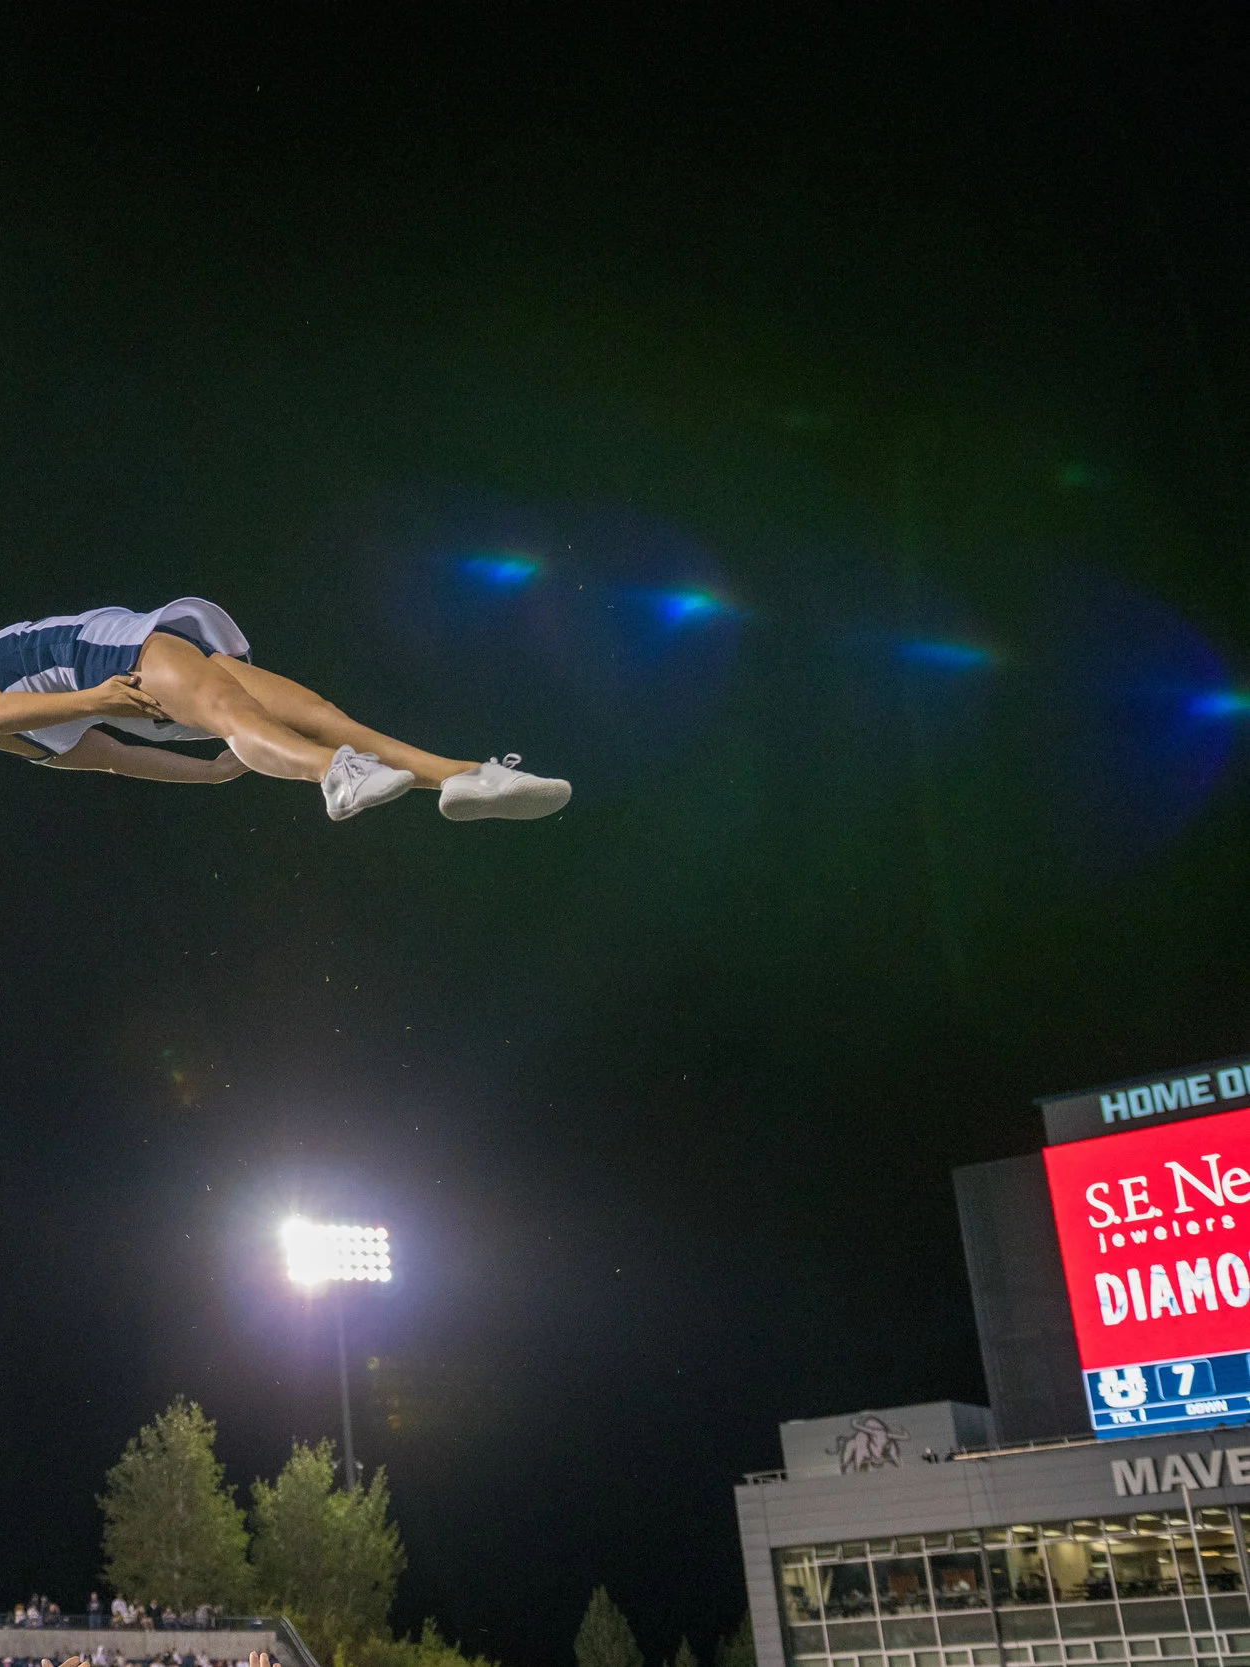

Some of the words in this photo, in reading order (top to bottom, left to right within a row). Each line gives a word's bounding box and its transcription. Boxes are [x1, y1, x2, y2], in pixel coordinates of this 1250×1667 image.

[1101, 1074, 1216, 1124] HOME
[1086, 1175, 1163, 1229] S.E.
[1164, 1153, 1250, 1214] Ne
[1098, 1214, 1236, 1254] jewelers
[1172, 1363, 1195, 1396] 7
[1185, 1400, 1229, 1416] DOWN
[1110, 1447, 1250, 1496] MAVE
